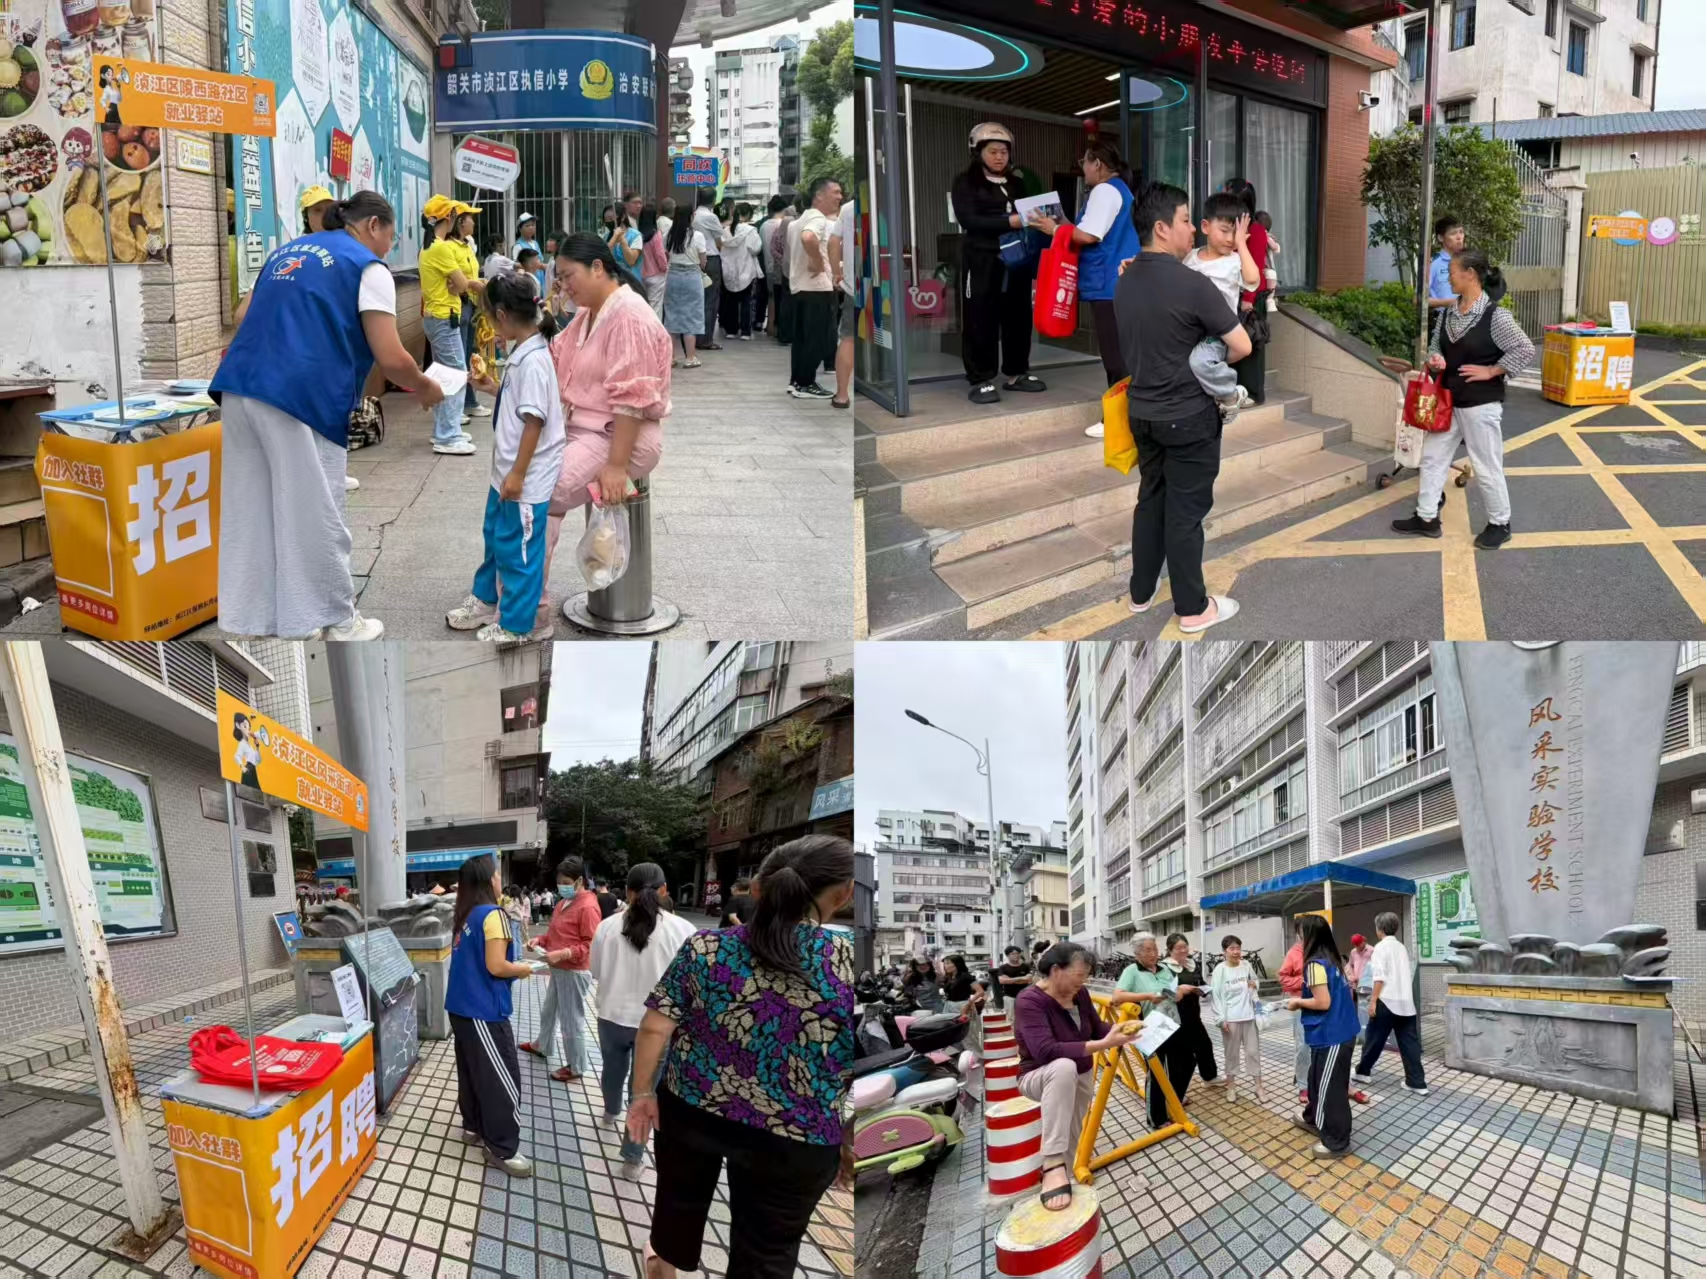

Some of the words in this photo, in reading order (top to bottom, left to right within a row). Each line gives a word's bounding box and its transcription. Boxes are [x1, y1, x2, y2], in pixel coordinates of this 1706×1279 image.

[446, 68, 569, 96] 韶关市浈江区执信小学
[164, 101, 224, 126] 就业驿站
[1574, 345, 1635, 391] 招聘
[42, 455, 105, 491] 加入社群
[127, 450, 212, 576] 招
[272, 733, 354, 801] 浈江区风采街道
[1568, 737, 1585, 841] EXPERIMENT
[296, 776, 343, 817] 就业驿站
[1527, 697, 1564, 894] 风采实验学校
[167, 1122, 243, 1163] 加入社群
[271, 1071, 376, 1229] 招聘
